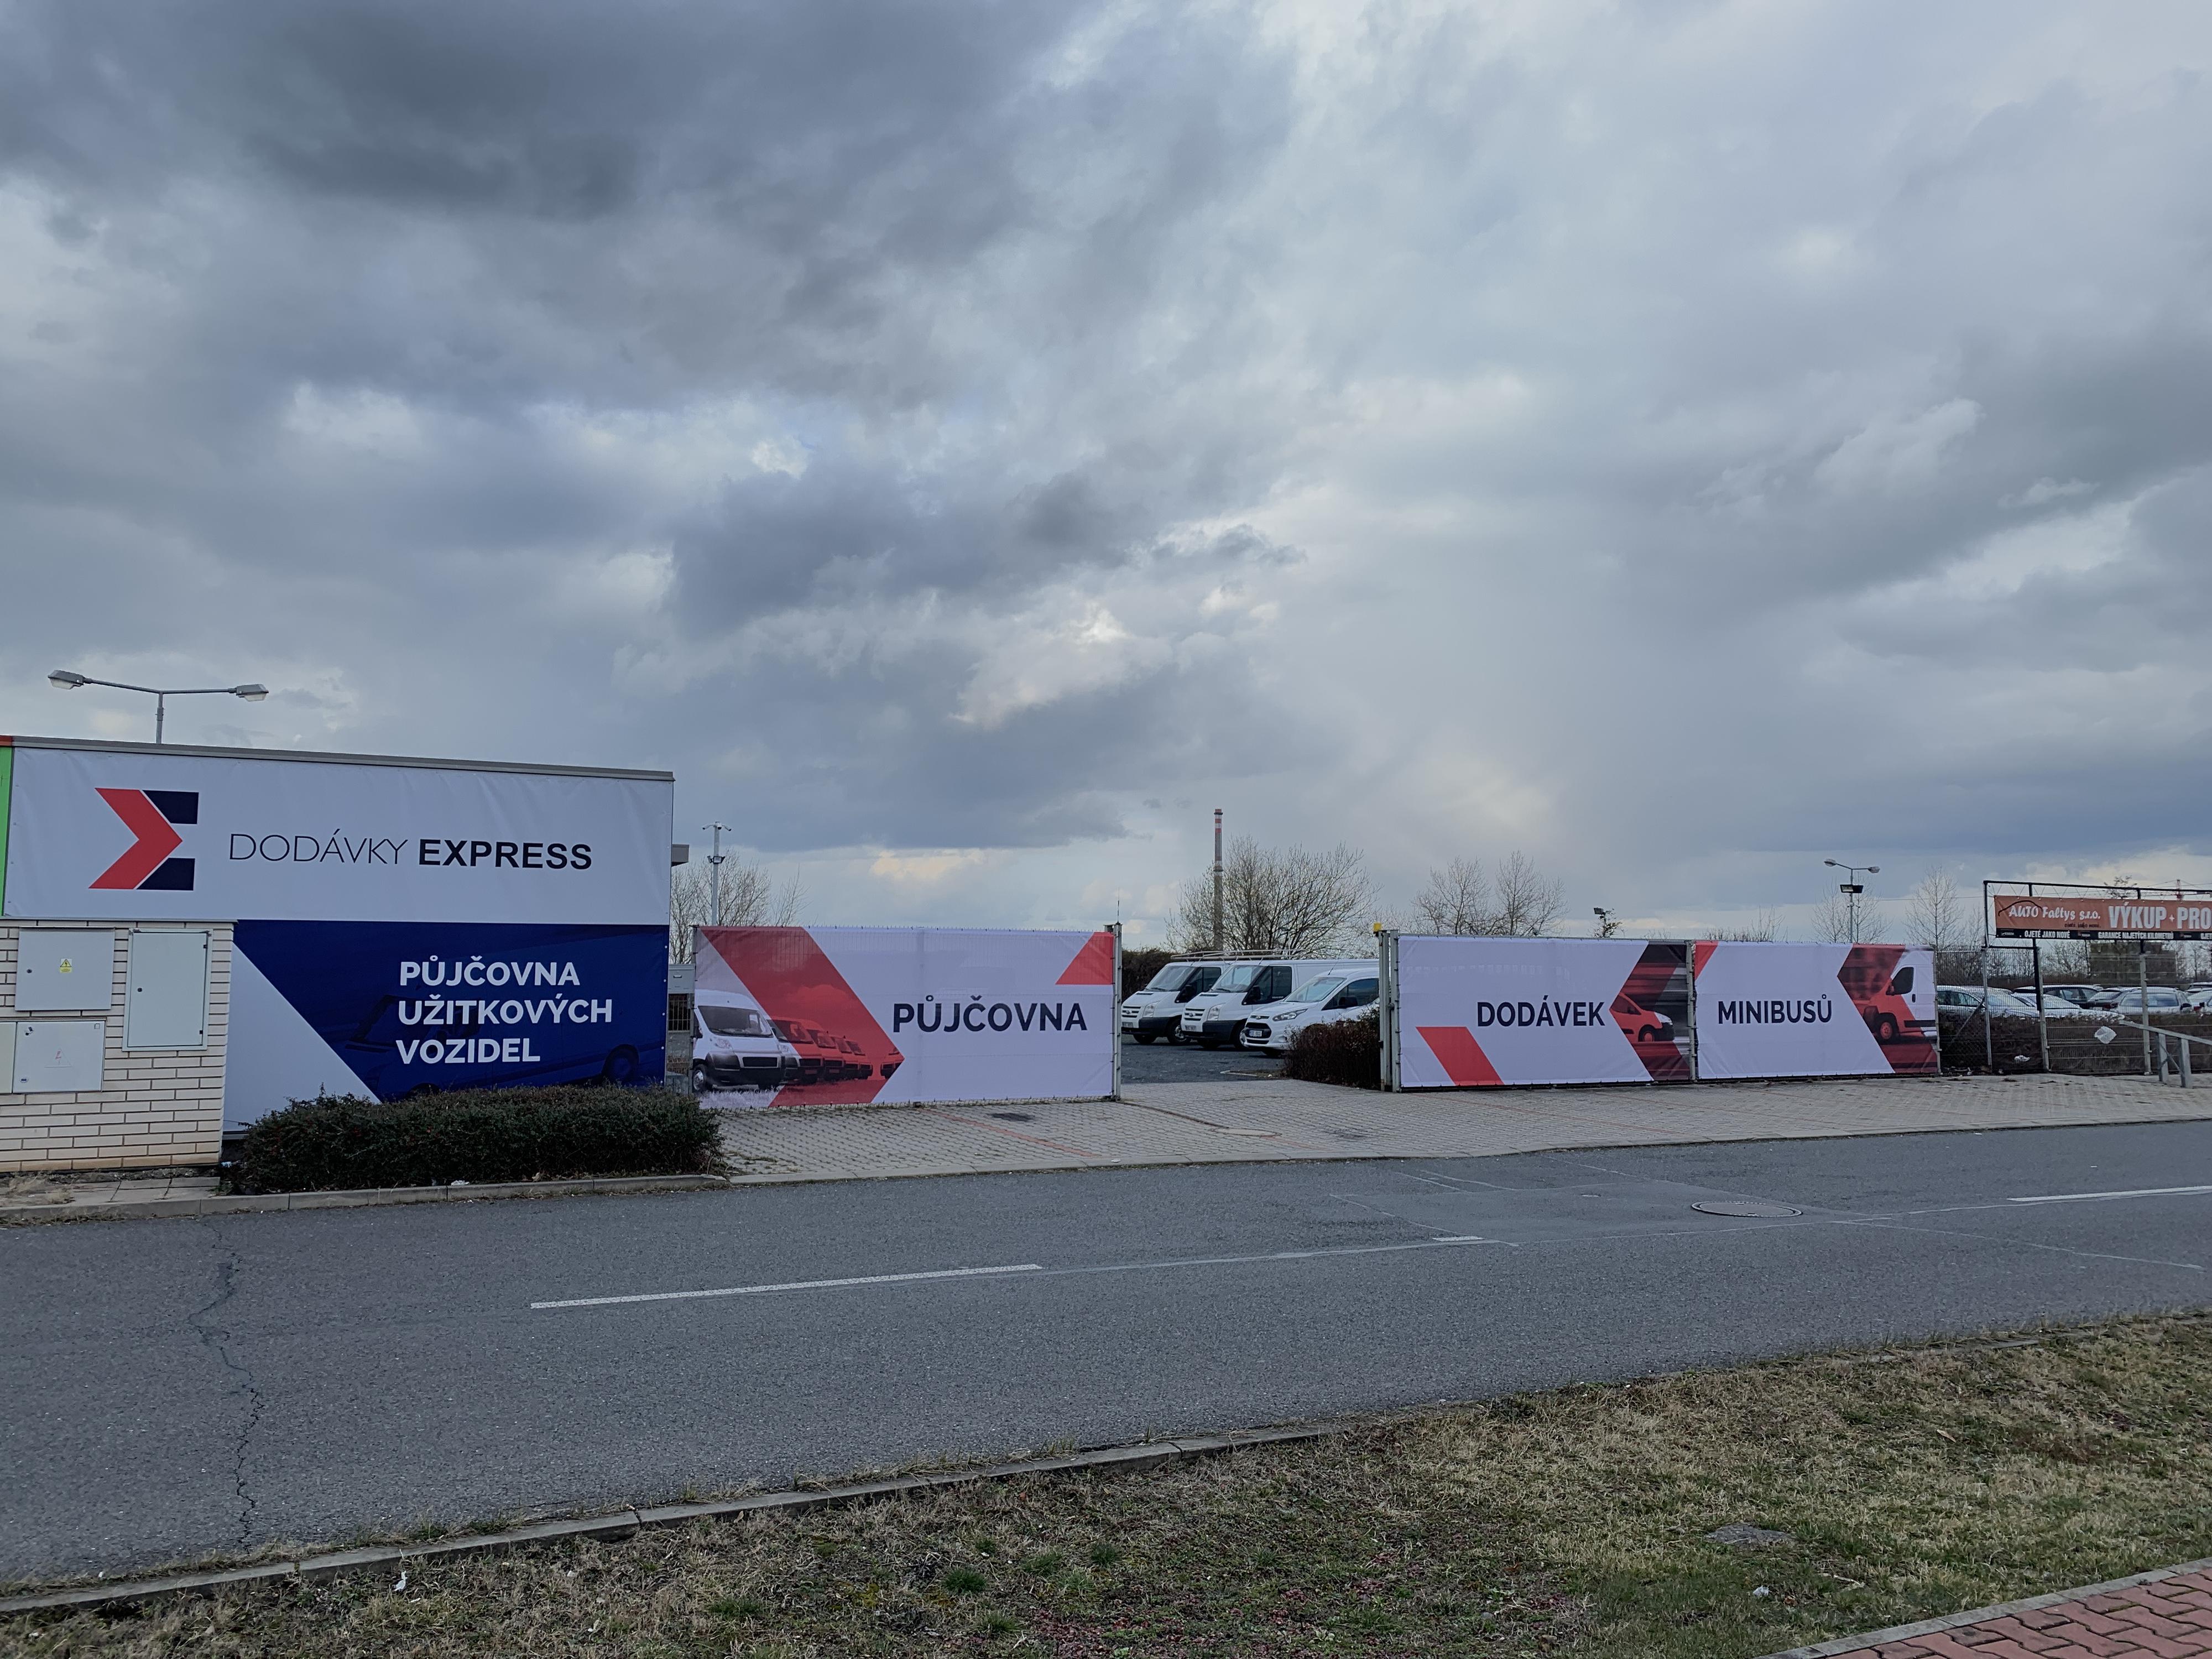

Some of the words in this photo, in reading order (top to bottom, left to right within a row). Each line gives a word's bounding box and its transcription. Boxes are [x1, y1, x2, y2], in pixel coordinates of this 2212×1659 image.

[229, 828, 408, 864] DODÁVKY
[419, 838, 592, 870] EXPRESS
[2042, 906, 2075, 921] Faltys
[2108, 901, 2167, 929] VÝKUP
[2024, 929, 2041, 938] OJETÉ
[2056, 930, 2070, 938] NOVÉ
[400, 955, 580, 986] PŮJČOVNA
[398, 993, 612, 1025] UŽITKOVÝCH
[893, 995, 1088, 1032] PŮJČOVNA
[1477, 995, 1605, 1027] DODÁVEK
[1718, 994, 1832, 1024] MINIBUSŮ
[396, 1038, 540, 1064] VOZIDEL
